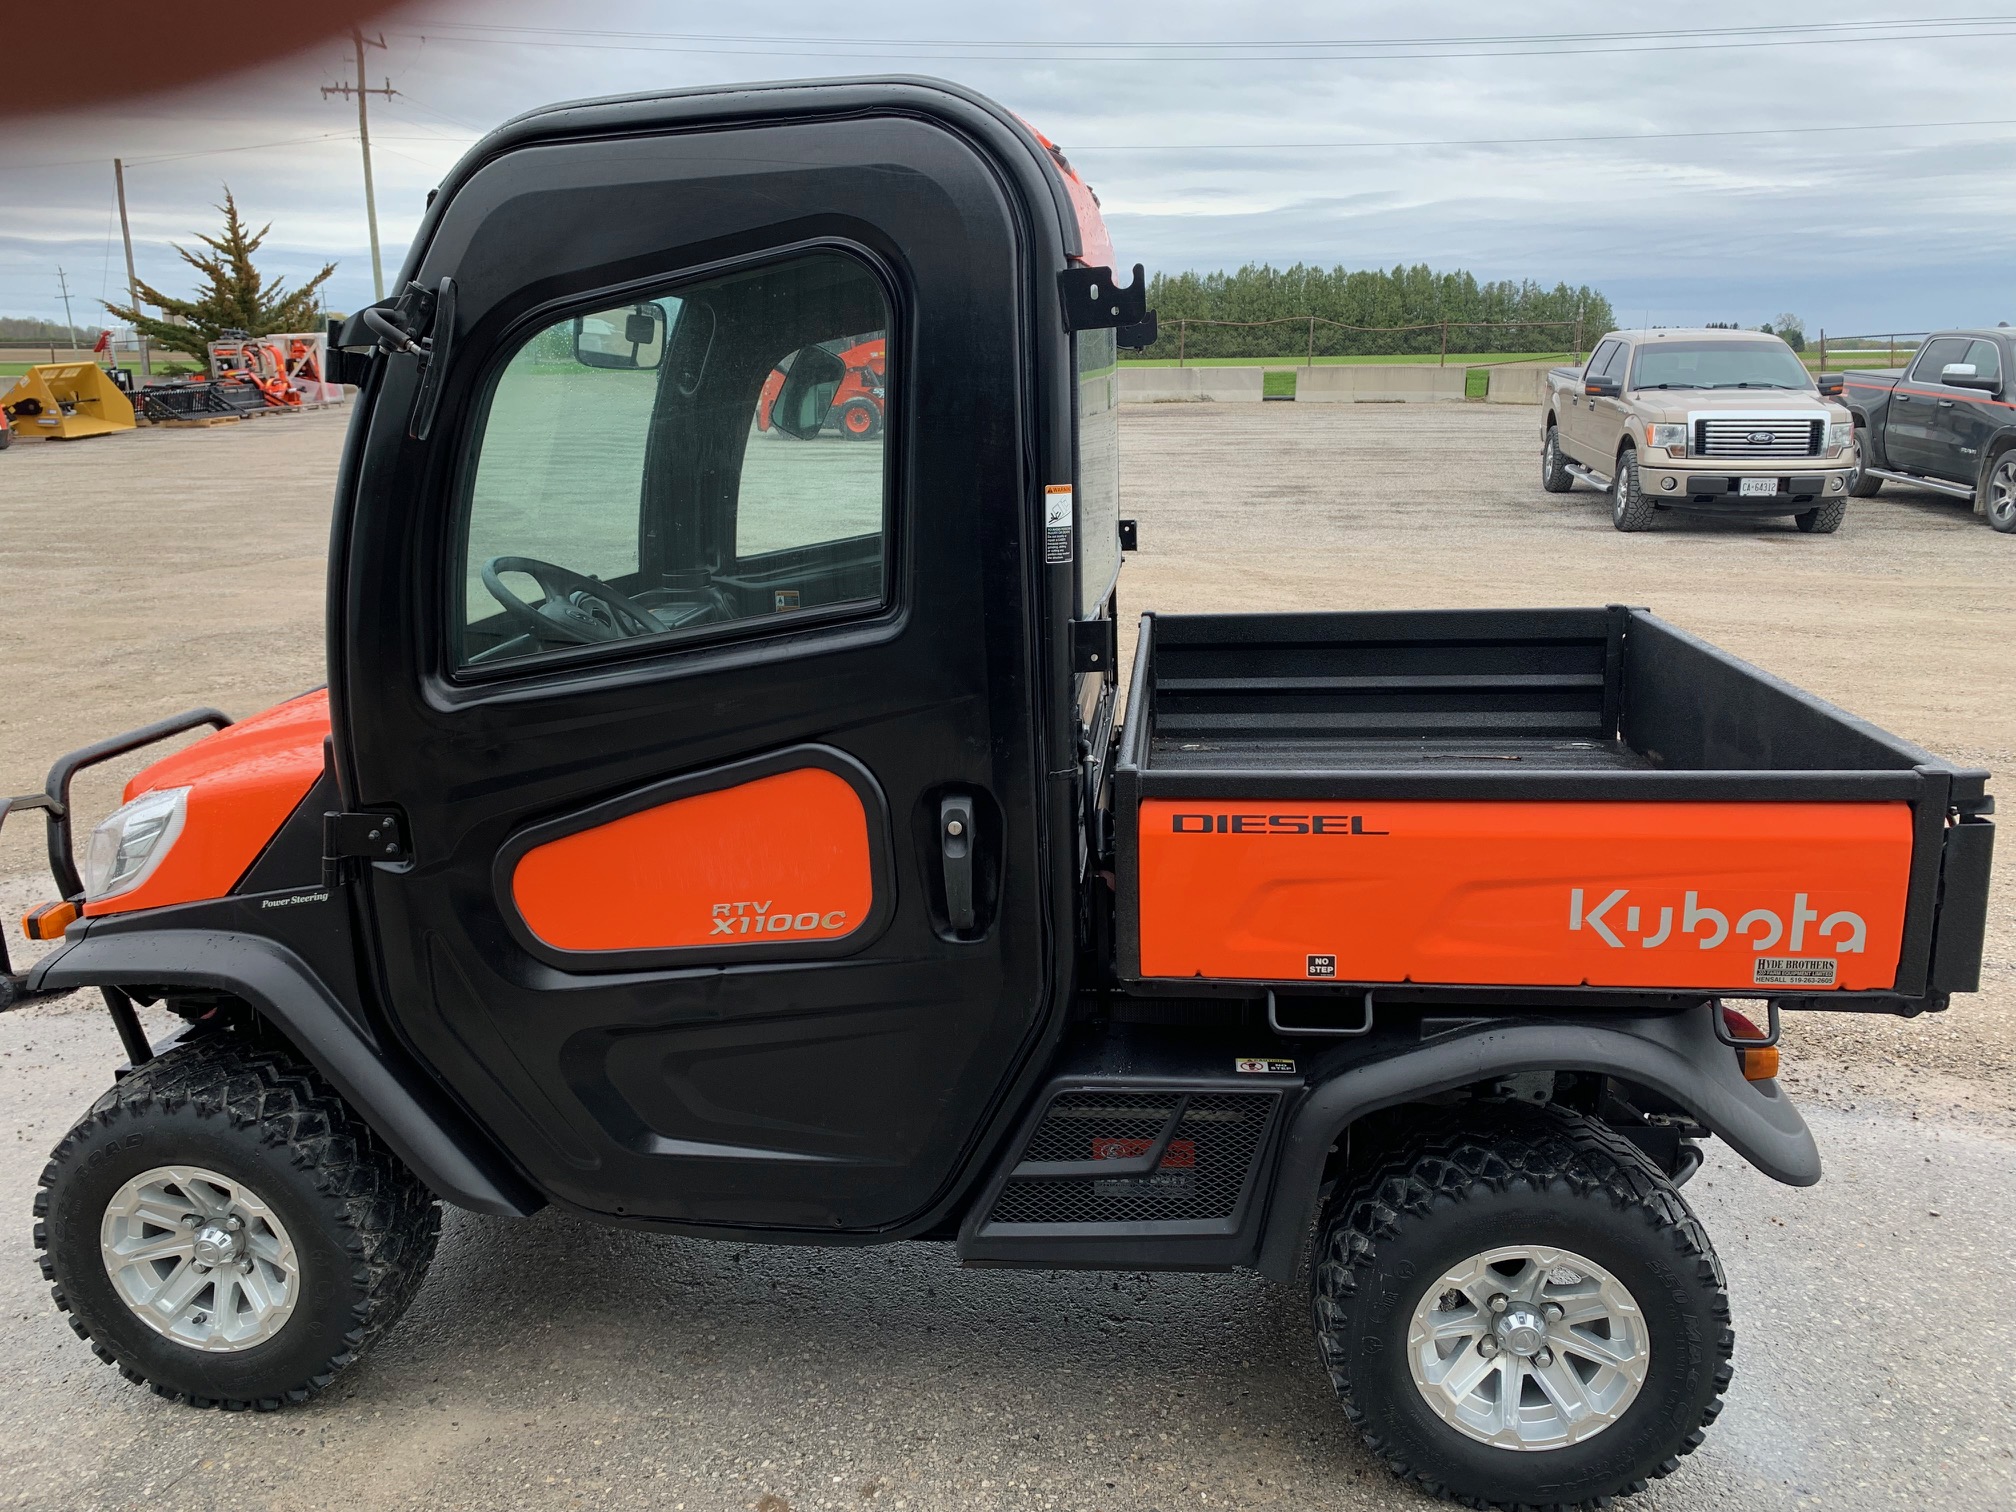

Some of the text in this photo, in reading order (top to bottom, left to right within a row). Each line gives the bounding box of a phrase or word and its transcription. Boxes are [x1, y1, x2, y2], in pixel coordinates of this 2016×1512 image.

[1172, 814, 1390, 836] DIESEL
[261, 892, 329, 909] Power Steering
[712, 900, 773, 917] RTV
[709, 911, 847, 936] X1100C
[1569, 888, 1867, 954] Kubota
[1309, 965, 1334, 973] STEP
[1314, 957, 1329, 965] NO
[1757, 958, 1835, 970] HYDE BROTHERS
